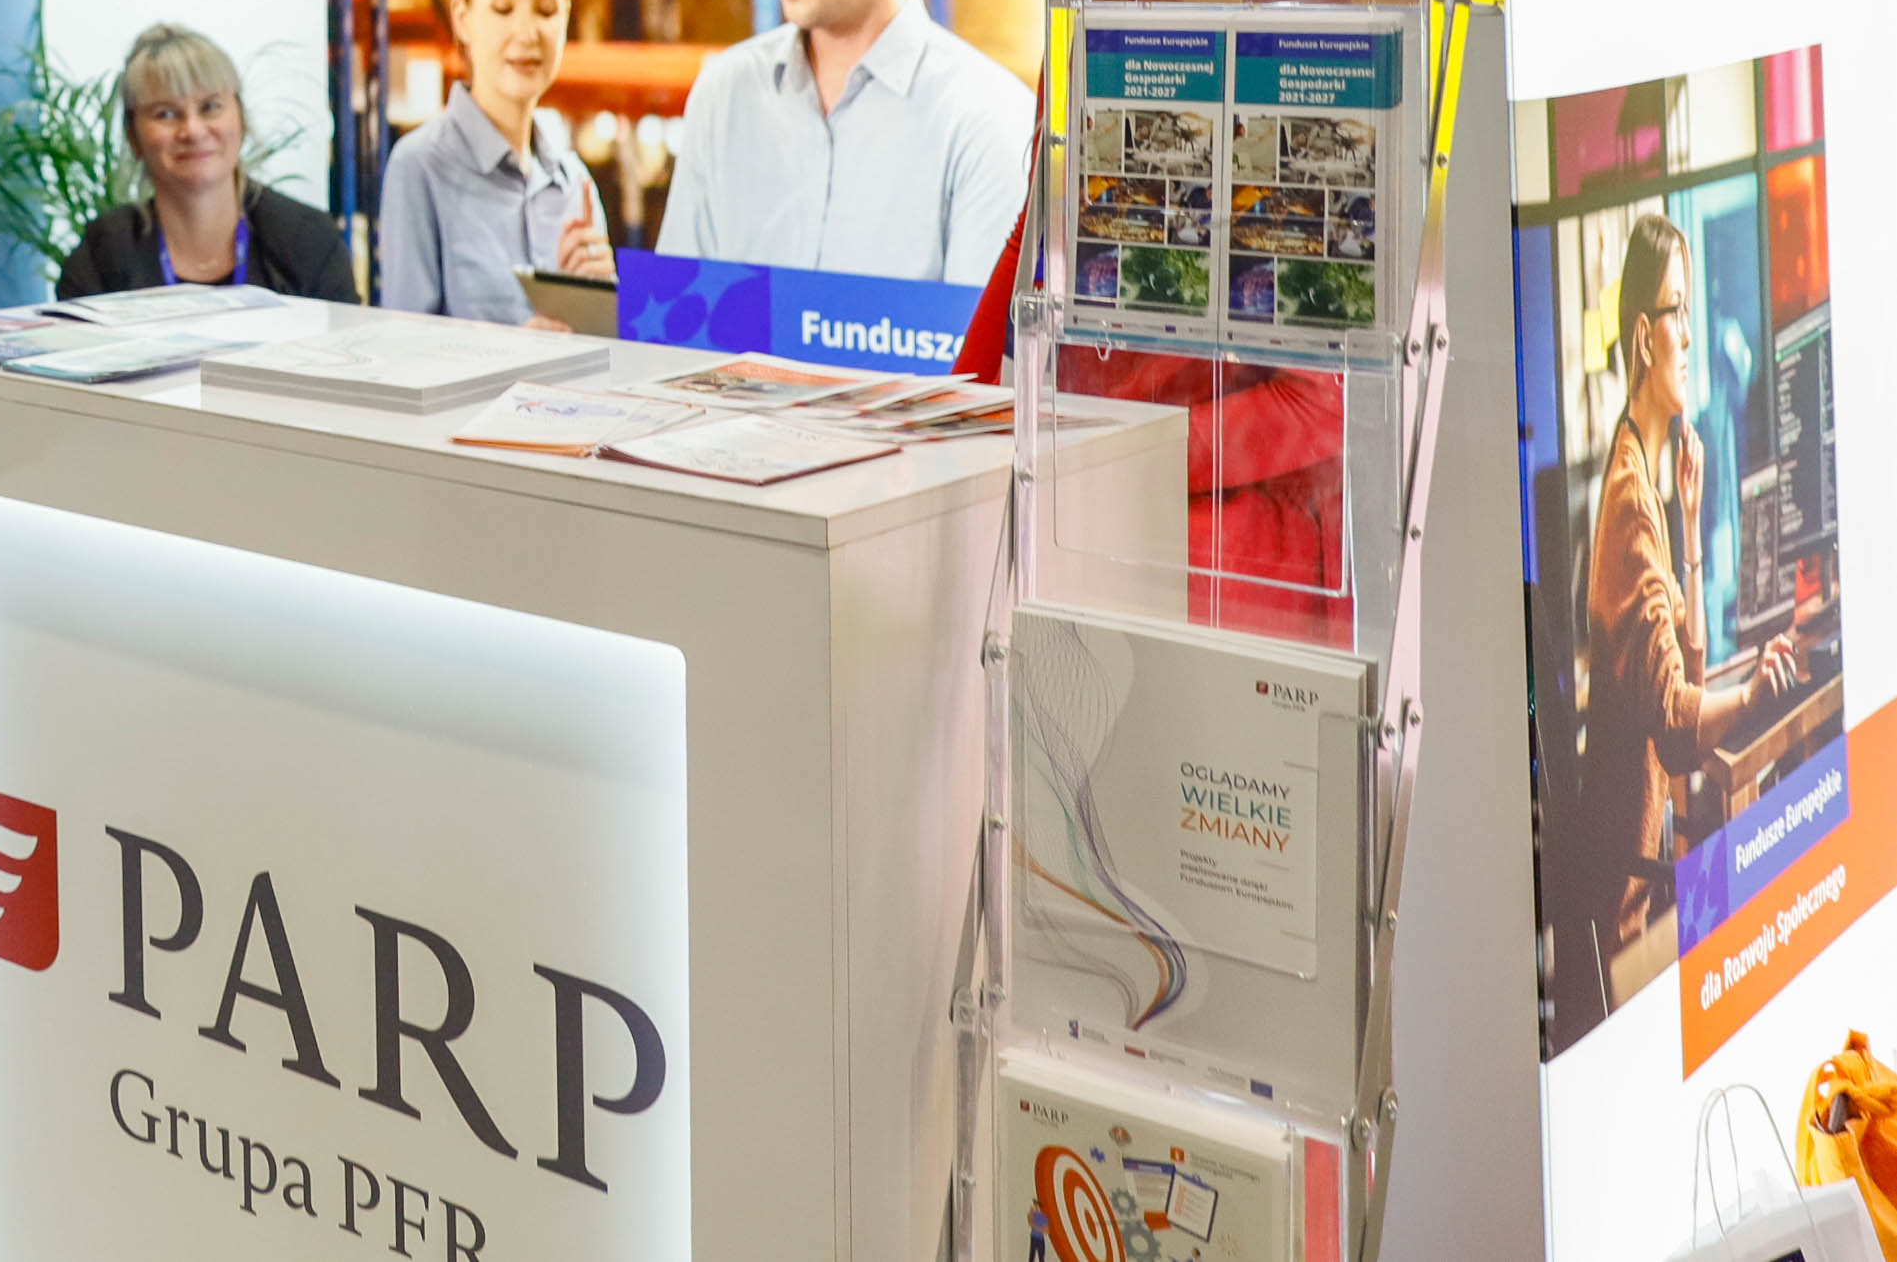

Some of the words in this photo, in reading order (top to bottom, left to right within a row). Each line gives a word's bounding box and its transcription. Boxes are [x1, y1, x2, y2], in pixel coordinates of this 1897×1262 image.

[1124, 58, 1142, 71] dla
[1143, 59, 1214, 76] Nowoczesnej
[1124, 72, 1186, 86] Gospodarki
[1279, 63, 1297, 76] dla
[1124, 84, 1177, 98] 2021-2027
[1279, 78, 1346, 91] Gospodarki
[1278, 90, 1336, 105] 2021-2027
[1271, 682, 1319, 707] PARP
[1181, 781, 1292, 830] WIELKIE
[1180, 804, 1291, 854] ZMIANY
[1735, 815, 1785, 875] Fundusze
[1785, 767, 1843, 833] Europejskie
[1700, 969, 1722, 1011] dla
[1723, 922, 1776, 991] Rozwoju
[1776, 863, 1847, 946] Społecznego
[104, 823, 667, 1195] PARP
[109, 1068, 318, 1216] Grupa
[337, 1154, 488, 1262] PFR
